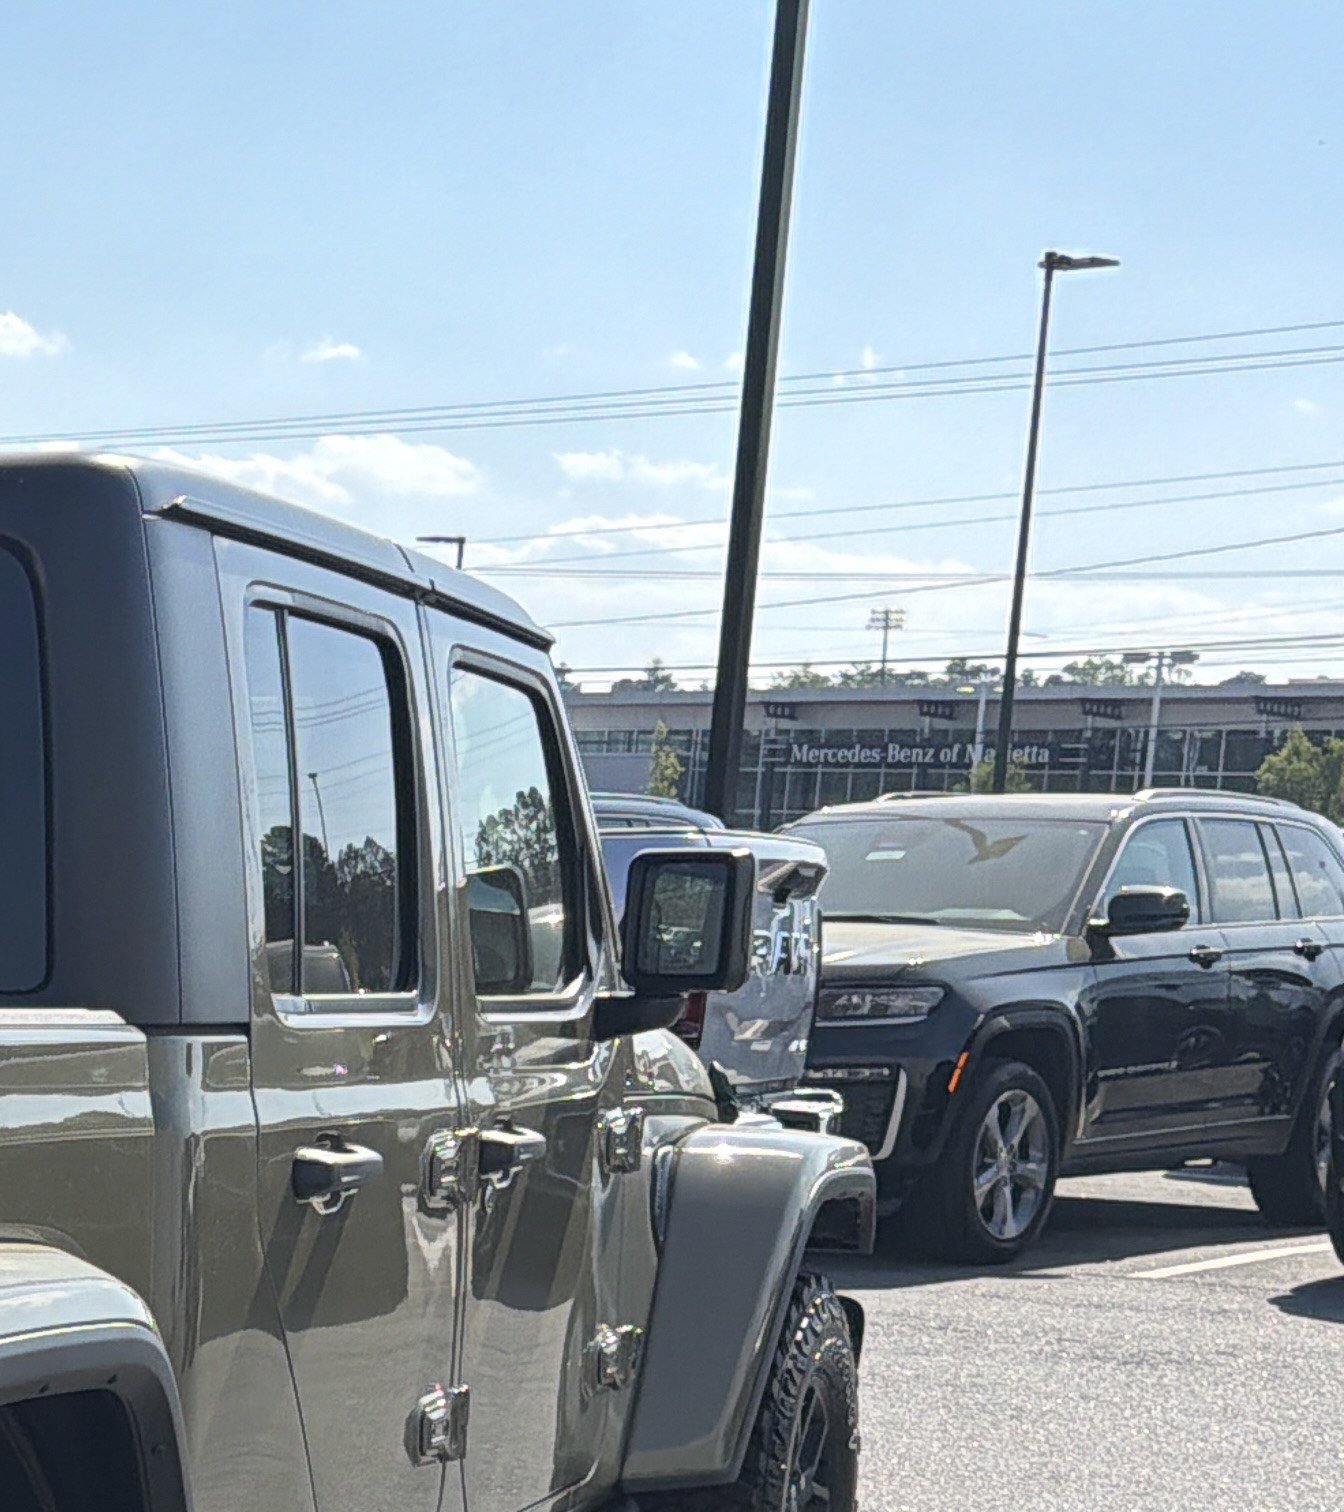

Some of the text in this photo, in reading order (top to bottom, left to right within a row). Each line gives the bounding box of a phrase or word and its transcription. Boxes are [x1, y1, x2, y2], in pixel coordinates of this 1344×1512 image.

[790, 743, 1050, 763] Mercedes-Benz of Maietta
